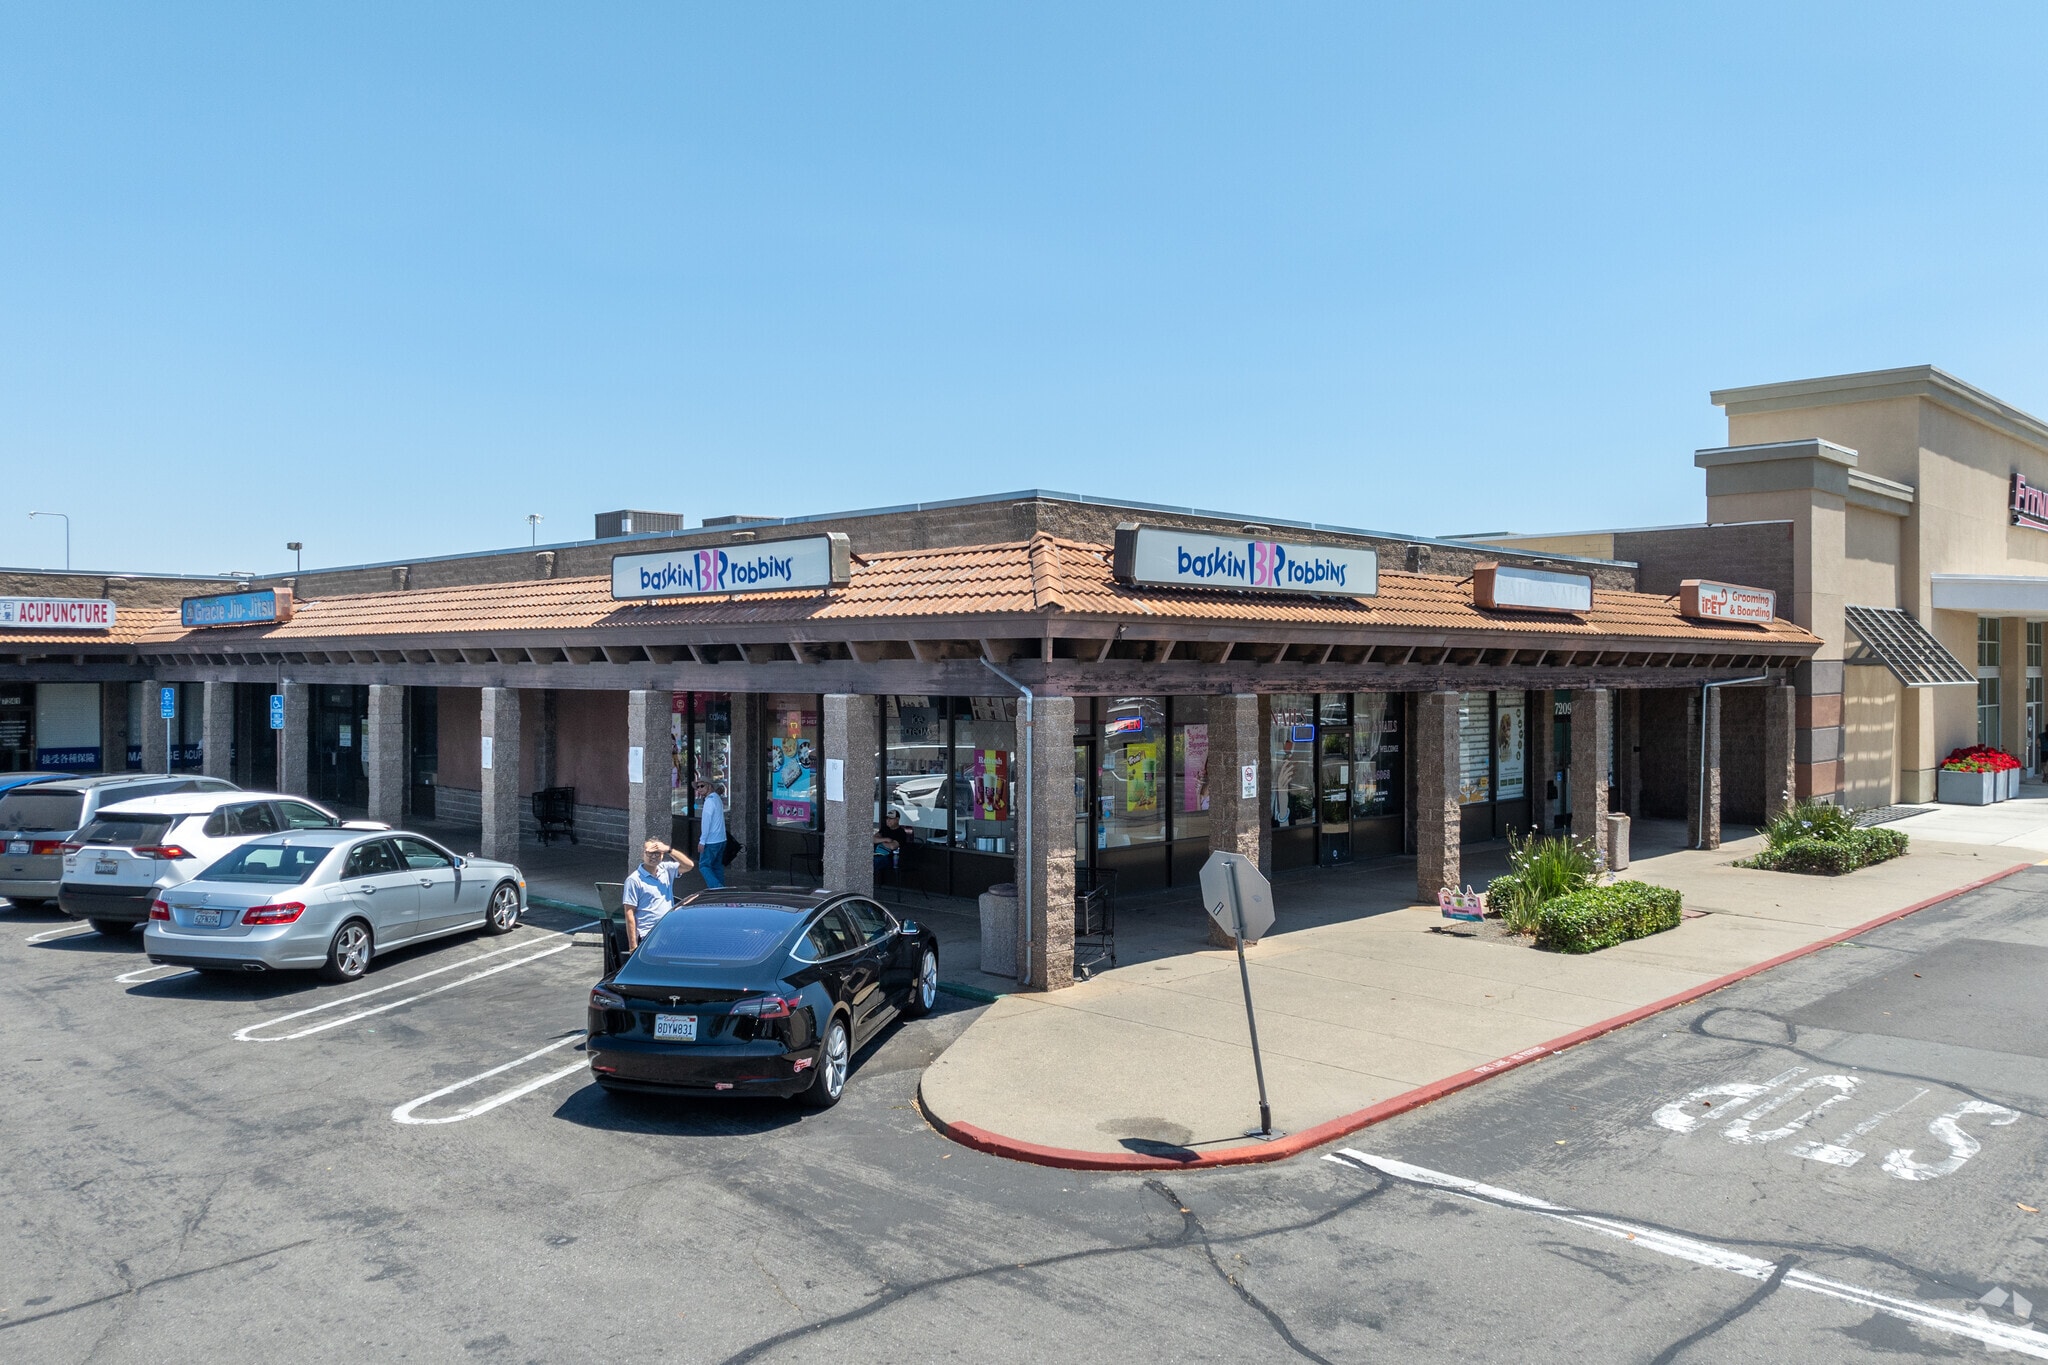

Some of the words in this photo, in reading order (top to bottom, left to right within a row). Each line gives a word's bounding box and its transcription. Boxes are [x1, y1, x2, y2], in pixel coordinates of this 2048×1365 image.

[640, 561, 693, 590] baskin
[731, 555, 792, 584] robbins
[1178, 545, 1246, 580] baskin
[1287, 558, 1347, 587] robbins
[1732, 591, 1769, 607] Grooming
[19, 602, 107, 623] ACUPUNCTURE
[195, 601, 225, 621] Gracie
[1729, 604, 1735, 615] &
[1737, 605, 1770, 620] Boarding
[1555, 702, 1572, 715] 7209
[657, 1022, 693, 1036] 8DYW831
[1652, 1066, 2021, 1181] STOP
